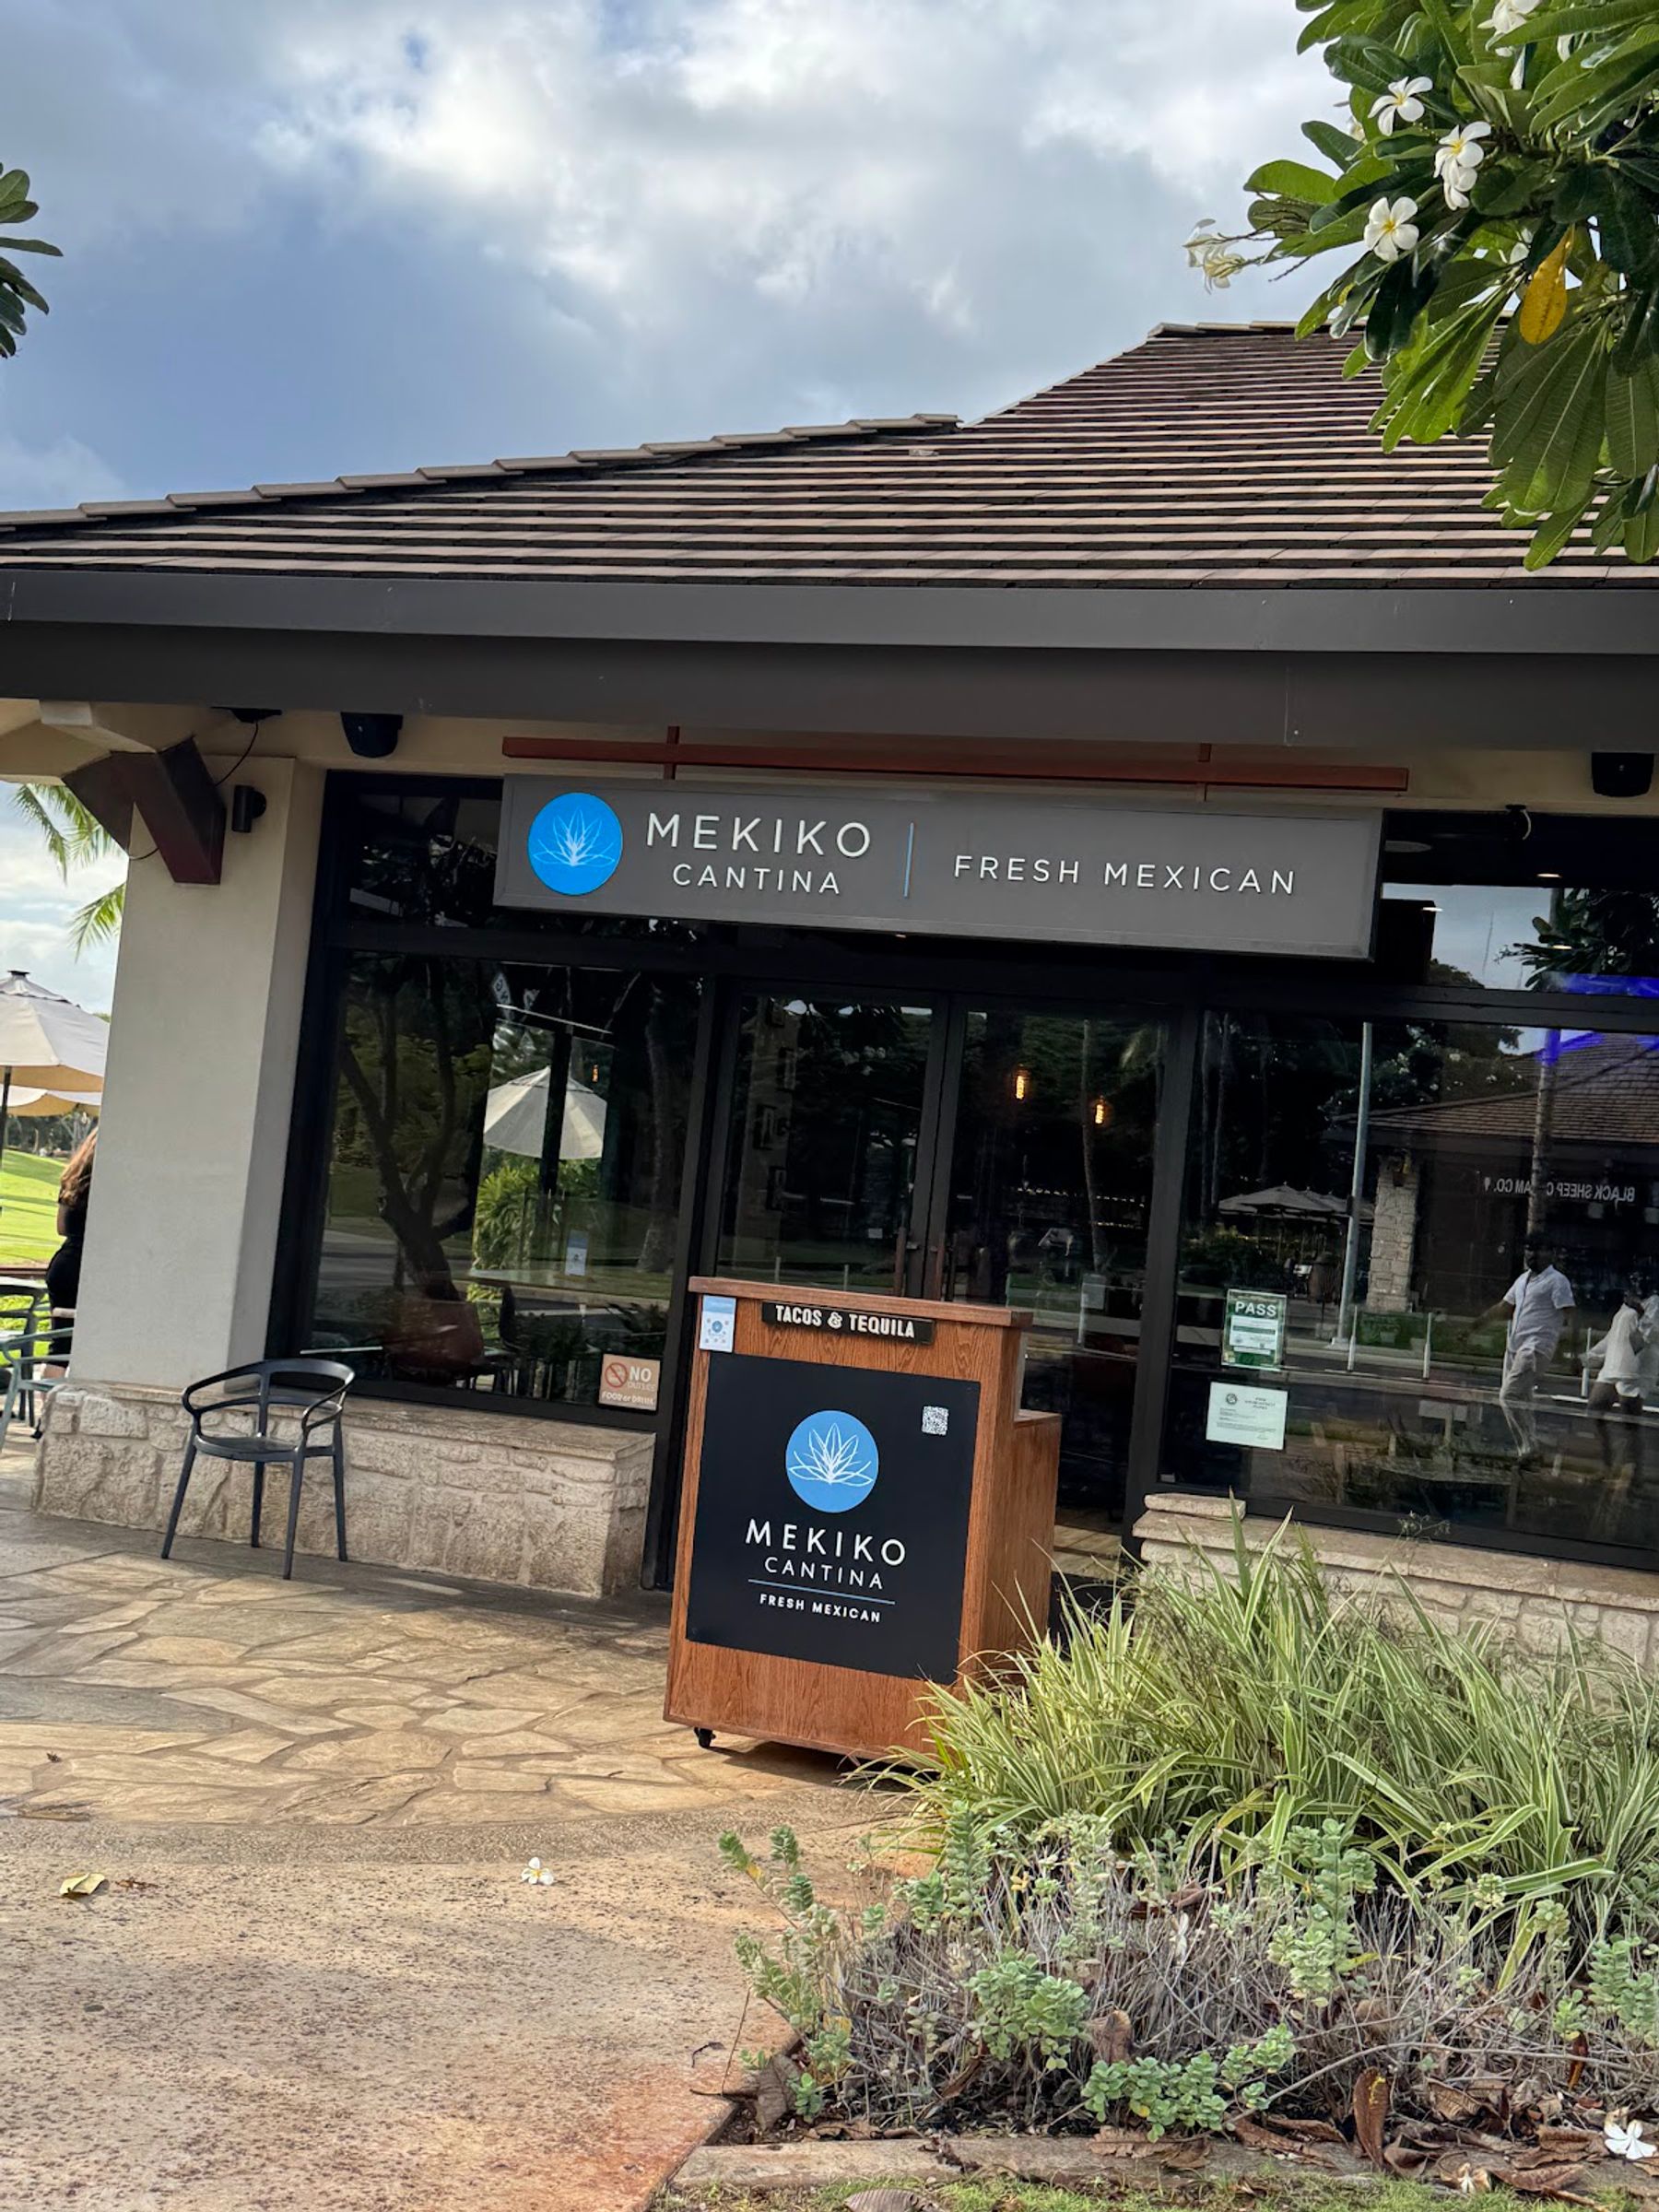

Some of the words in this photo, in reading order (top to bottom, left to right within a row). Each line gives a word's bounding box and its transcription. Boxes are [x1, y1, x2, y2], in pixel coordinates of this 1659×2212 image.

[647, 812, 871, 858] MEKIKO
[673, 863, 841, 895] CANTINA
[953, 854, 1080, 885] FRESH
[1104, 861, 1296, 895] MEXICAN
[776, 1304, 822, 1327] TACOS
[828, 1312, 843, 1329] &
[849, 1312, 915, 1339] TEQUILA
[1235, 1300, 1277, 1317] PASS
[629, 1366, 653, 1382] NO
[745, 1518, 906, 1566] MEKIKO
[764, 1556, 883, 1590] CANTINA
[759, 1594, 805, 1610] FRESH
[812, 1602, 881, 1623] MEXICAN
